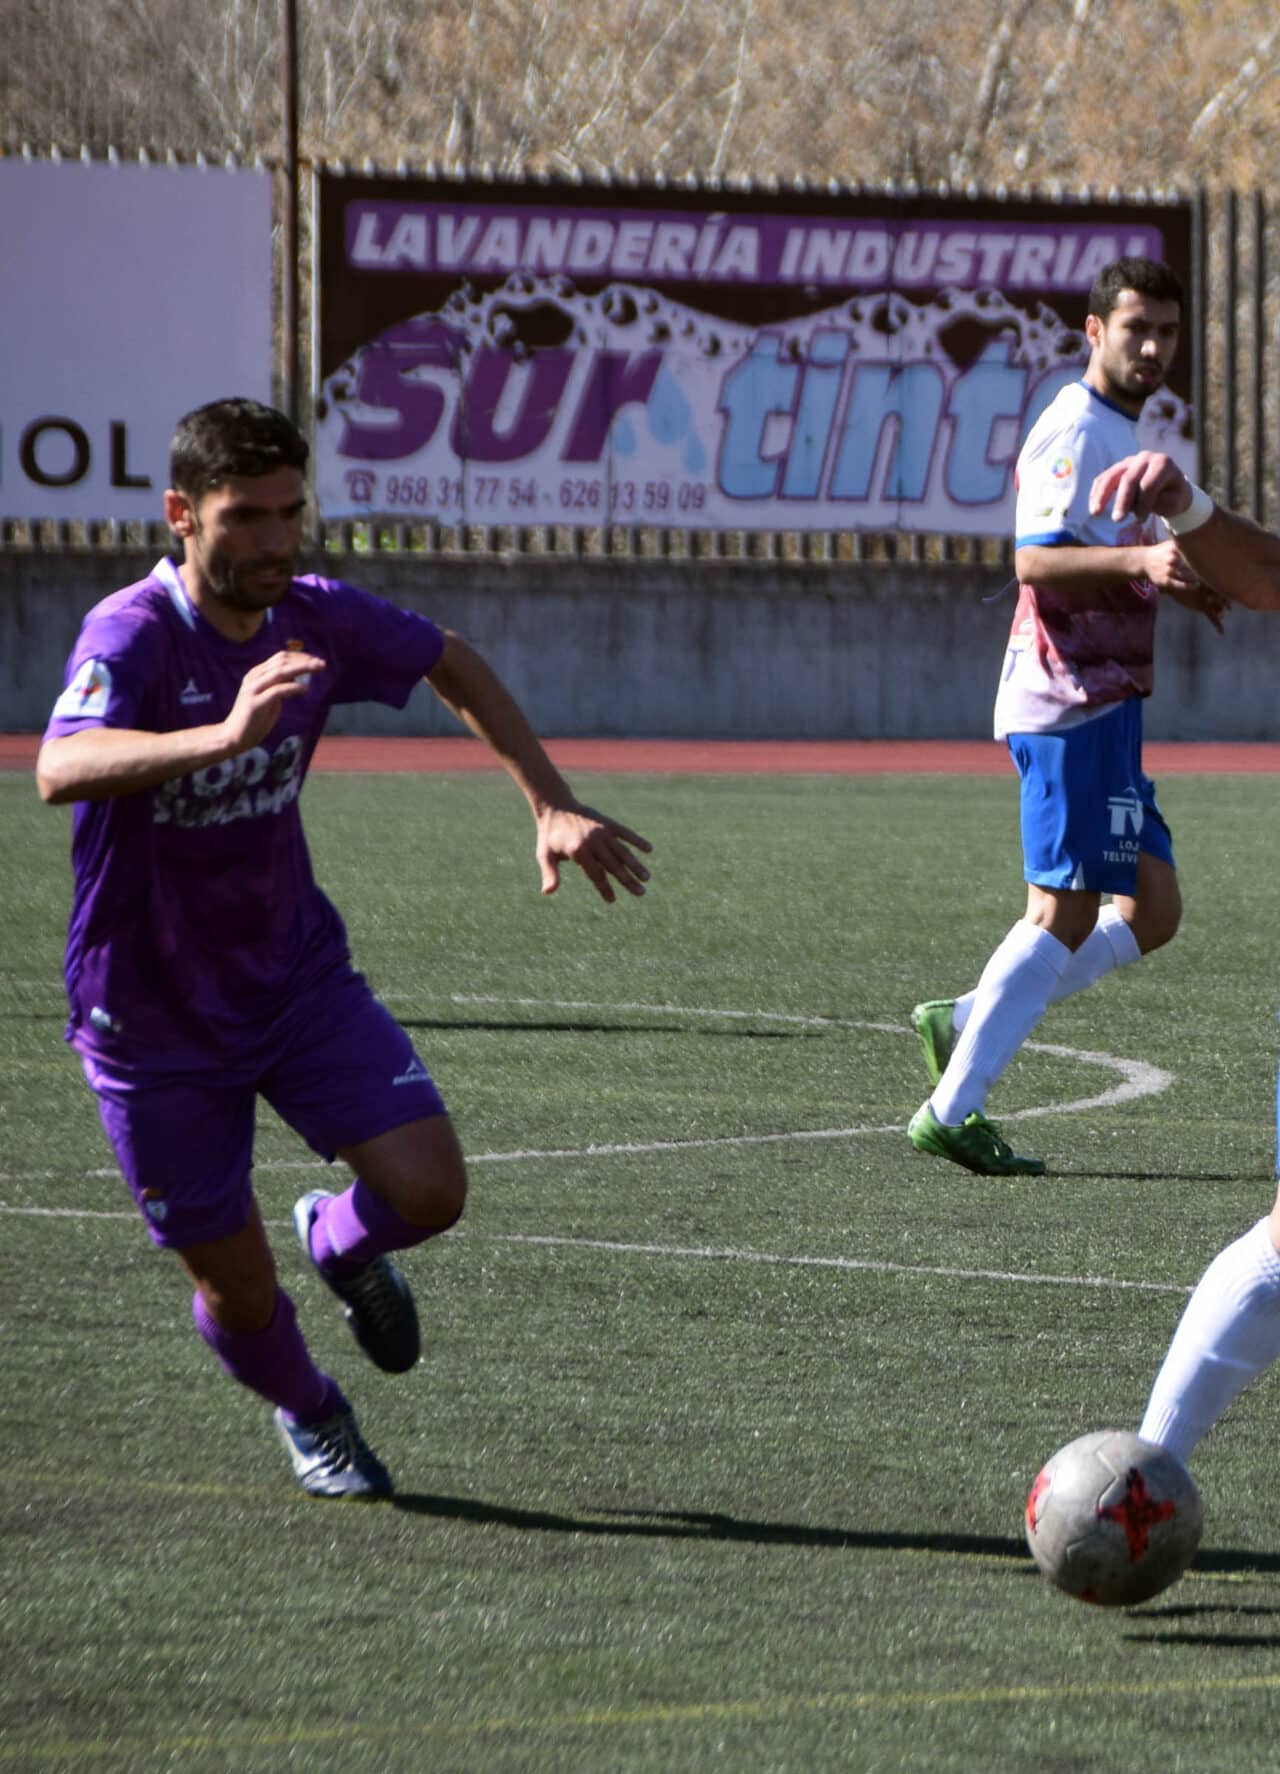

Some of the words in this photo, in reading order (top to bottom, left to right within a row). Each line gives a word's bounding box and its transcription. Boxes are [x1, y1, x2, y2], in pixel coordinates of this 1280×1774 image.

[351, 211, 760, 277] LAVANDERÍA
[336, 319, 664, 463] Sur
[0, 414, 153, 488] OL
[385, 475, 428, 502] 958
[436, 477, 463, 506] 31
[474, 477, 500, 505] 77
[507, 479, 537, 507] 54
[559, 480, 600, 508] 626
[608, 481, 636, 510] 13
[643, 482, 671, 511] 59
[677, 483, 706, 511] 09
